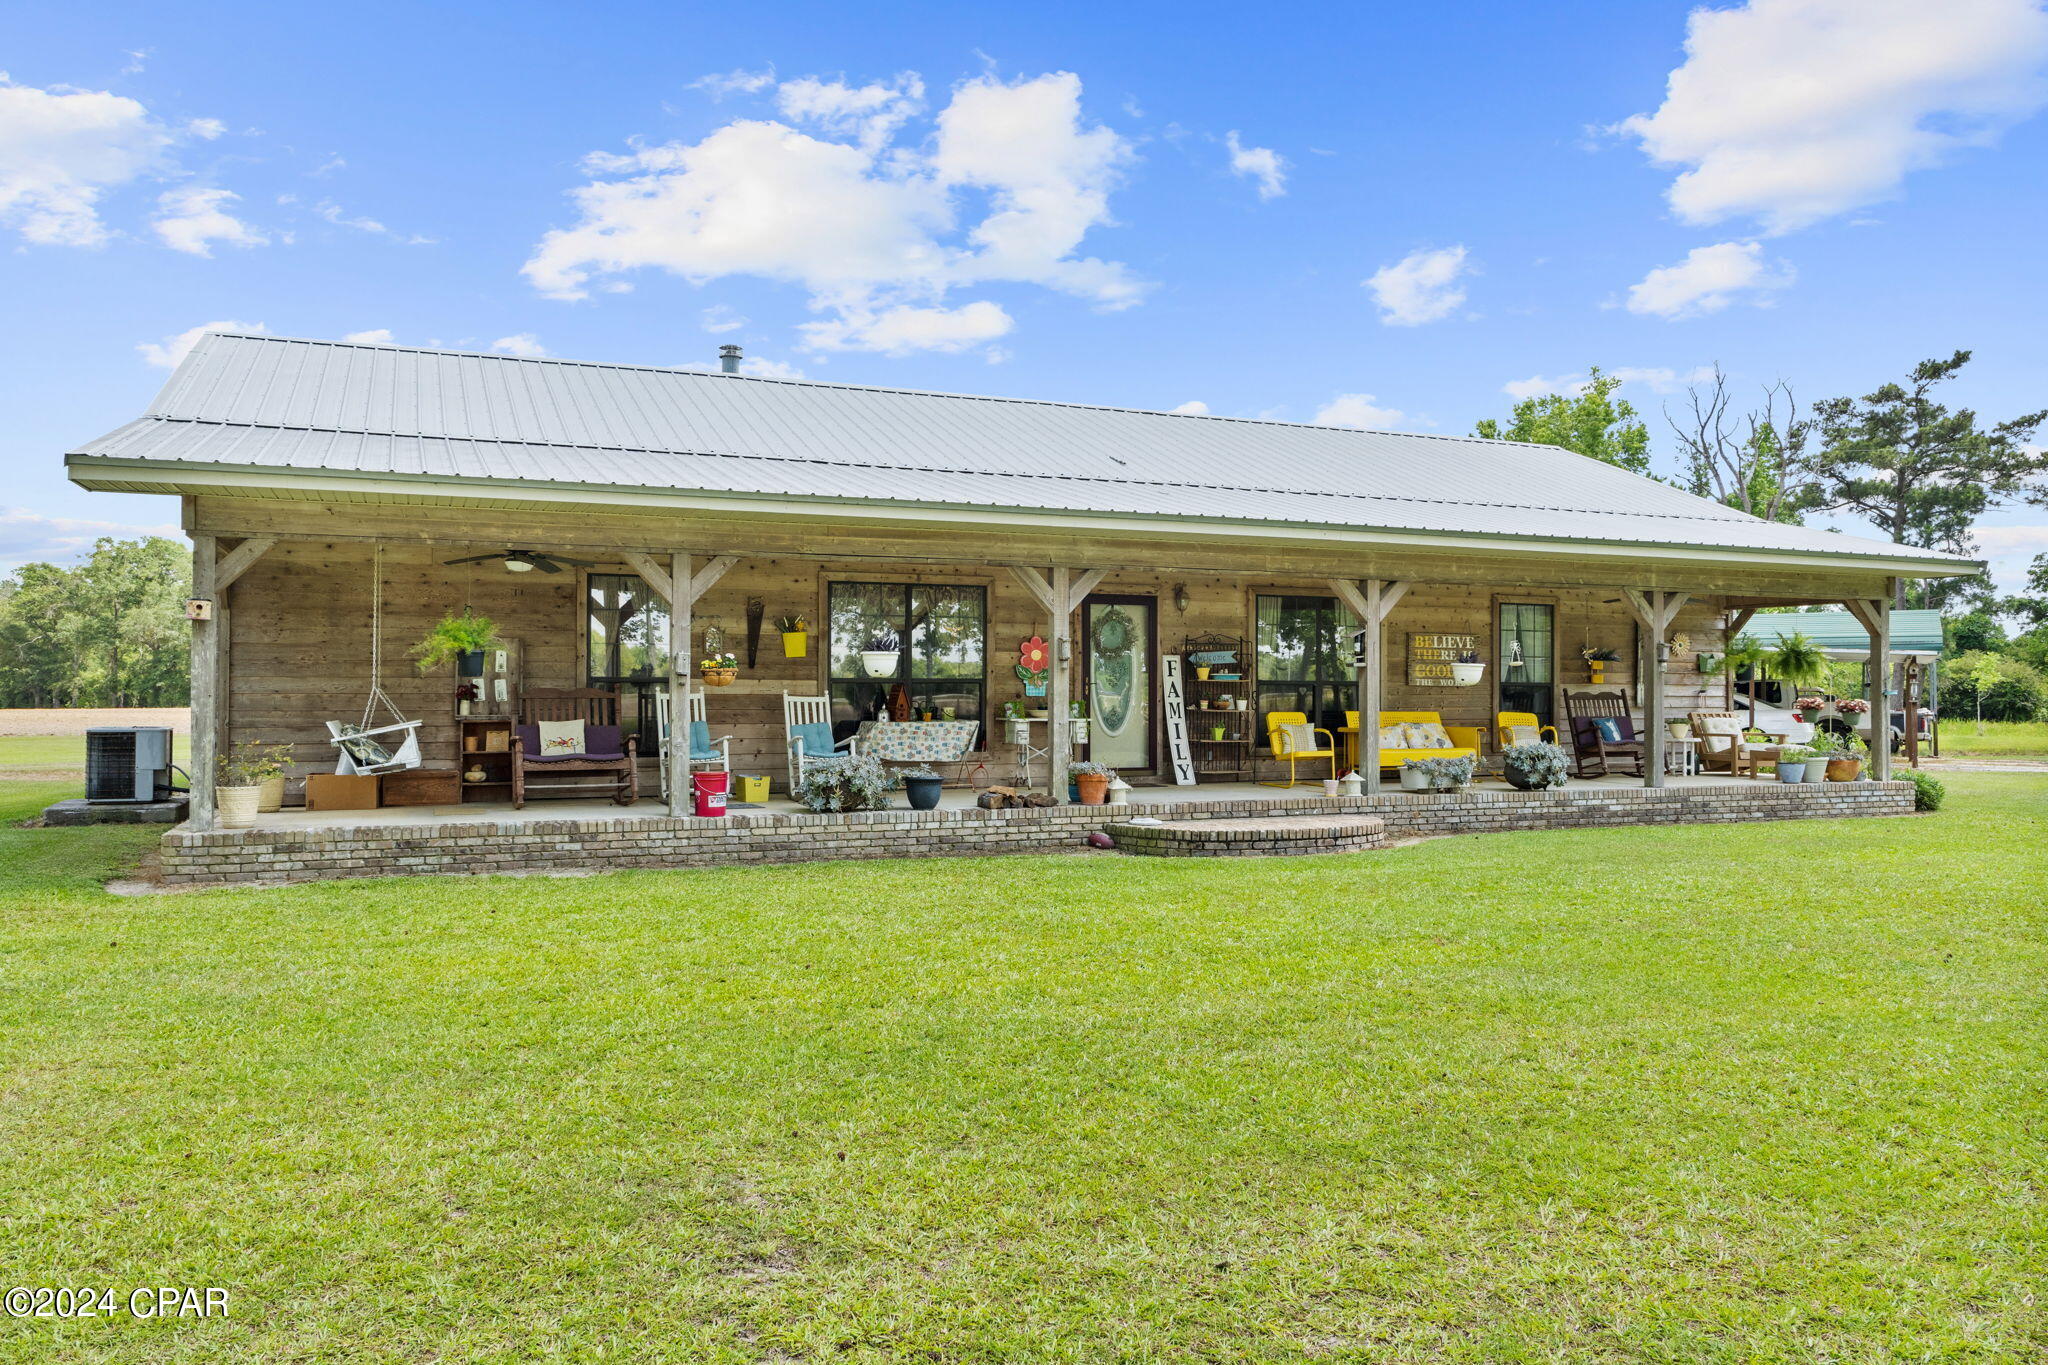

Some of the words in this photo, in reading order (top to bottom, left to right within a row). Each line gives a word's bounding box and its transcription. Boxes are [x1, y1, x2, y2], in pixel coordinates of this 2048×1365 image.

[1415, 635, 1474, 648] BELIEVE
[1415, 649, 1456, 660] THERE
[1166, 660, 1190, 780] FAMILY
